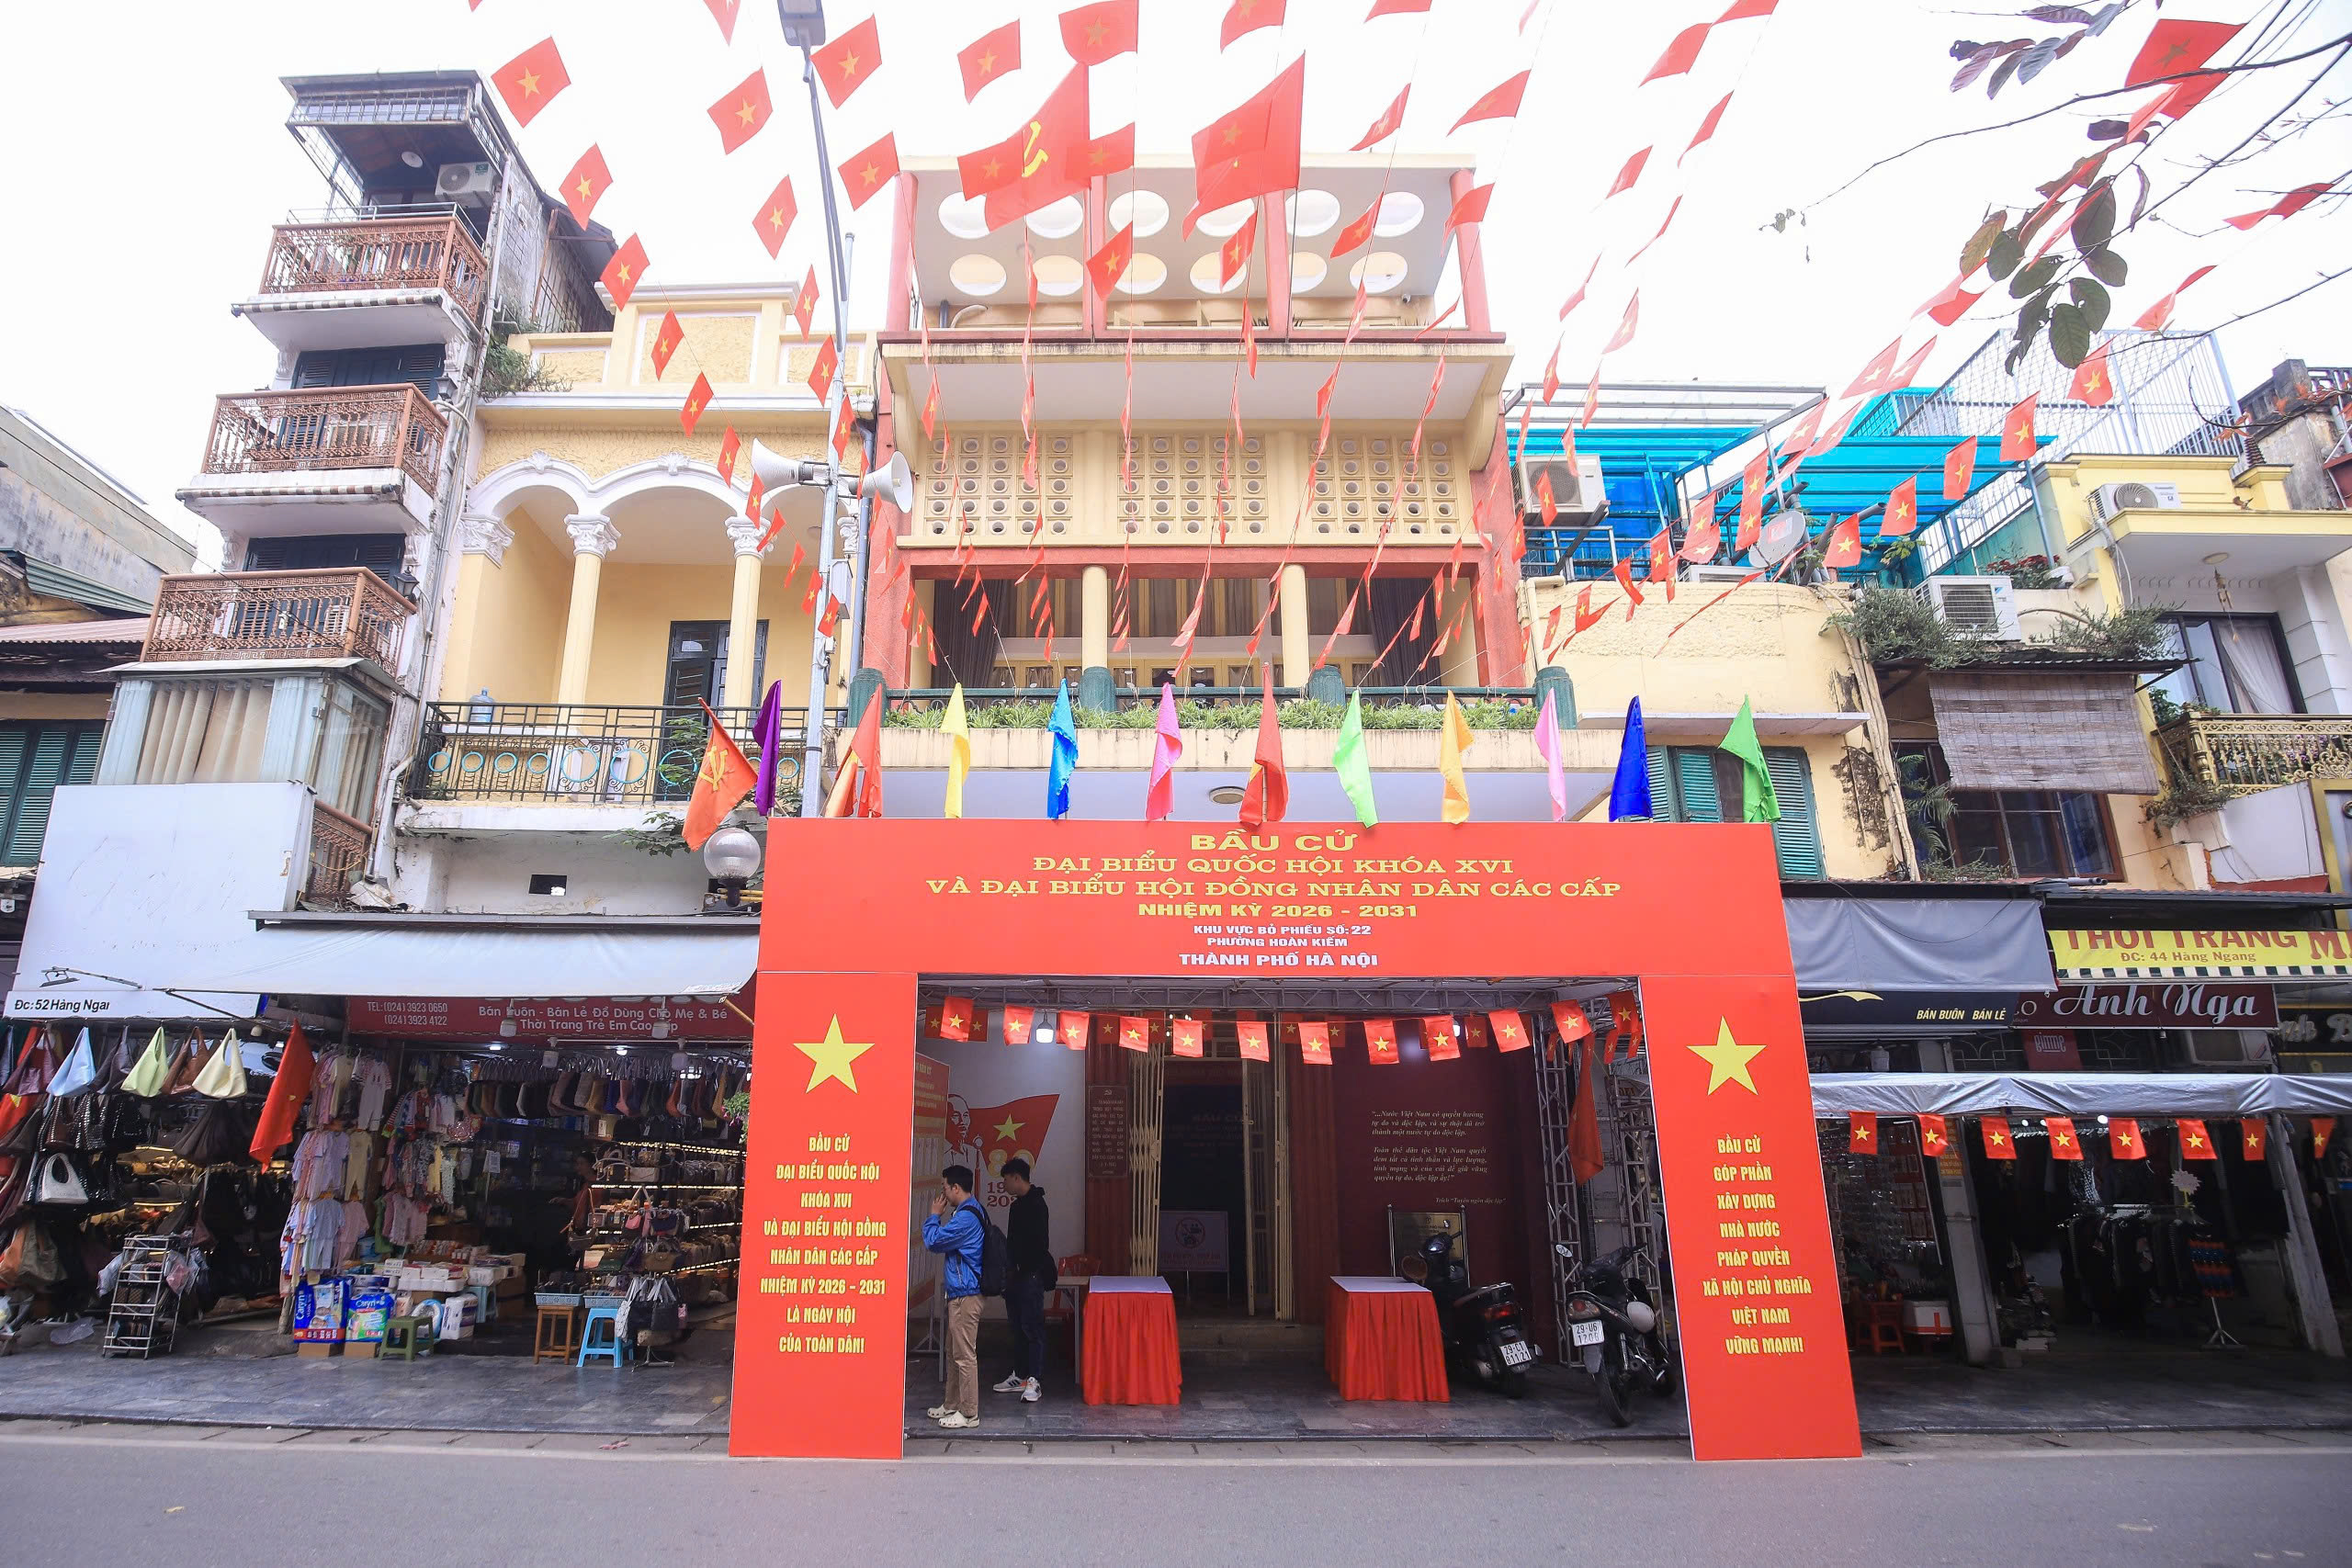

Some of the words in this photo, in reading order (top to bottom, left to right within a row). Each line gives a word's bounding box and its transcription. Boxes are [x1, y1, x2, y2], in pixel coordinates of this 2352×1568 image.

[1191, 829, 1279, 852] BẦU
[1295, 829, 1358, 852] CỬ
[1034, 857, 1091, 874] ĐẠI
[1101, 849, 1177, 872] BIỂU
[1187, 852, 1276, 874] QUỐC
[1285, 855, 1343, 877] HỘI
[1353, 856, 1446, 874] KHÓA
[1454, 860, 1514, 874] XVI
[926, 875, 970, 895] VÀ
[981, 880, 1039, 897] ĐẠI
[1049, 873, 1125, 896] BIỂU
[1136, 877, 1194, 898] HỘI
[1205, 875, 1298, 897] ĐỒNG
[1307, 879, 1402, 897] NHÂN
[1412, 879, 1481, 897] DÂN
[1490, 879, 1551, 897] CÁC
[1560, 876, 1622, 897] CẤP
[1139, 901, 1222, 919] NHIỆM
[1231, 902, 1261, 917] KỲ
[1271, 905, 1332, 918] 2026
[1359, 905, 1418, 918] 2031
[1193, 925, 1222, 935] KHU
[1226, 925, 1253, 937] VỰC
[1258, 922, 1276, 935] BỎ
[1281, 923, 1323, 935] PHIẾU
[1207, 937, 1265, 947] PHƯỜNG
[1269, 936, 1308, 947] HOÀN
[1312, 936, 1348, 947] KIẾM
[2307, 931, 2352, 960] M
[1180, 953, 1250, 965] THÀNH
[1257, 952, 1299, 966] PHỐ
[1306, 953, 1335, 966] HÀ
[1340, 953, 1378, 969] NỘI
[2120, 952, 2145, 962] ĐC:
[2150, 952, 2168, 962] 44
[2173, 951, 2209, 963] Hàng
[2213, 951, 2256, 963] Ngang
[51, 998, 81, 1013] Hàng
[407, 1002, 426, 1012] 3923
[428, 1002, 447, 1012] 0650
[479, 1006, 501, 1017] Bán
[548, 1007, 570, 1018] Bán
[573, 1006, 587, 1018] Lẻ
[614, 1007, 643, 1021] Dùng
[675, 1008, 695, 1021] Mẹ
[698, 1009, 707, 1019] &
[712, 1008, 728, 1020] Bé
[1917, 1007, 1937, 1020] BÁN
[1939, 1007, 1965, 1020] BUÔN
[1972, 1007, 1993, 1021] BÁN
[1995, 1007, 2007, 1021] LẺ
[384, 1014, 406, 1025] (024)
[408, 1015, 427, 1025] 3923
[429, 1015, 447, 1026] 4122
[520, 1018, 546, 1030] Thời
[551, 1019, 582, 1032] Trang
[586, 1018, 605, 1031] Trẻ
[609, 1020, 627, 1031] Em
[808, 1132, 831, 1152] BẦU
[834, 1133, 851, 1152] CỬ
[1717, 1133, 1742, 1154] BẦU
[1745, 1134, 1761, 1154] CỬ
[775, 1164, 795, 1183] ĐẠI
[798, 1158, 824, 1179] BIỂU
[827, 1159, 856, 1180] QUỐC
[860, 1162, 880, 1183] HỘI
[1713, 1165, 1737, 1182] GÓP
[1740, 1160, 1772, 1181] PHẦN
[987, 1181, 1007, 1194] 19
[800, 1190, 831, 1208] KHÓA
[833, 1192, 852, 1208] XVI
[1716, 1191, 1739, 1210] XÂY
[1742, 1193, 1776, 1213] DỰNG
[763, 1217, 778, 1235] VÀ
[781, 1221, 800, 1239] ĐẠI
[804, 1214, 830, 1236] BIỂU
[832, 1219, 853, 1240] HỘI
[855, 1215, 887, 1237] ĐỒNG
[1719, 1220, 1745, 1238] NHÀ
[1747, 1220, 1781, 1237] NƯỚC
[770, 1247, 800, 1265] NHÂN
[804, 1247, 827, 1266] DÂN
[830, 1247, 853, 1266] CÁC
[855, 1245, 878, 1266] CẤP
[1717, 1248, 1748, 1267] PHÁP
[1751, 1245, 1791, 1267] QUYỀN
[760, 1275, 797, 1296] NHIỆM
[800, 1275, 816, 1294] KỲ
[818, 1279, 846, 1295] 2026
[859, 1279, 887, 1295] 2031
[1702, 1278, 1720, 1297] XÃ
[1722, 1277, 1744, 1299] HỘI
[1747, 1275, 1771, 1295] CHỦ
[1773, 1275, 1813, 1295] NGHĨA
[786, 1303, 800, 1324] LÀ
[804, 1305, 833, 1324] NGÀY
[836, 1305, 856, 1327] HỘI
[1732, 1305, 1758, 1327] VIỆT
[1760, 1307, 1791, 1324] NAM
[779, 1332, 802, 1353] CỦA
[805, 1335, 834, 1353] TOÀN
[837, 1335, 865, 1354] DÂN!
[1725, 1336, 1759, 1355] VỮNG
[1761, 1337, 1804, 1357] MẠNH!
